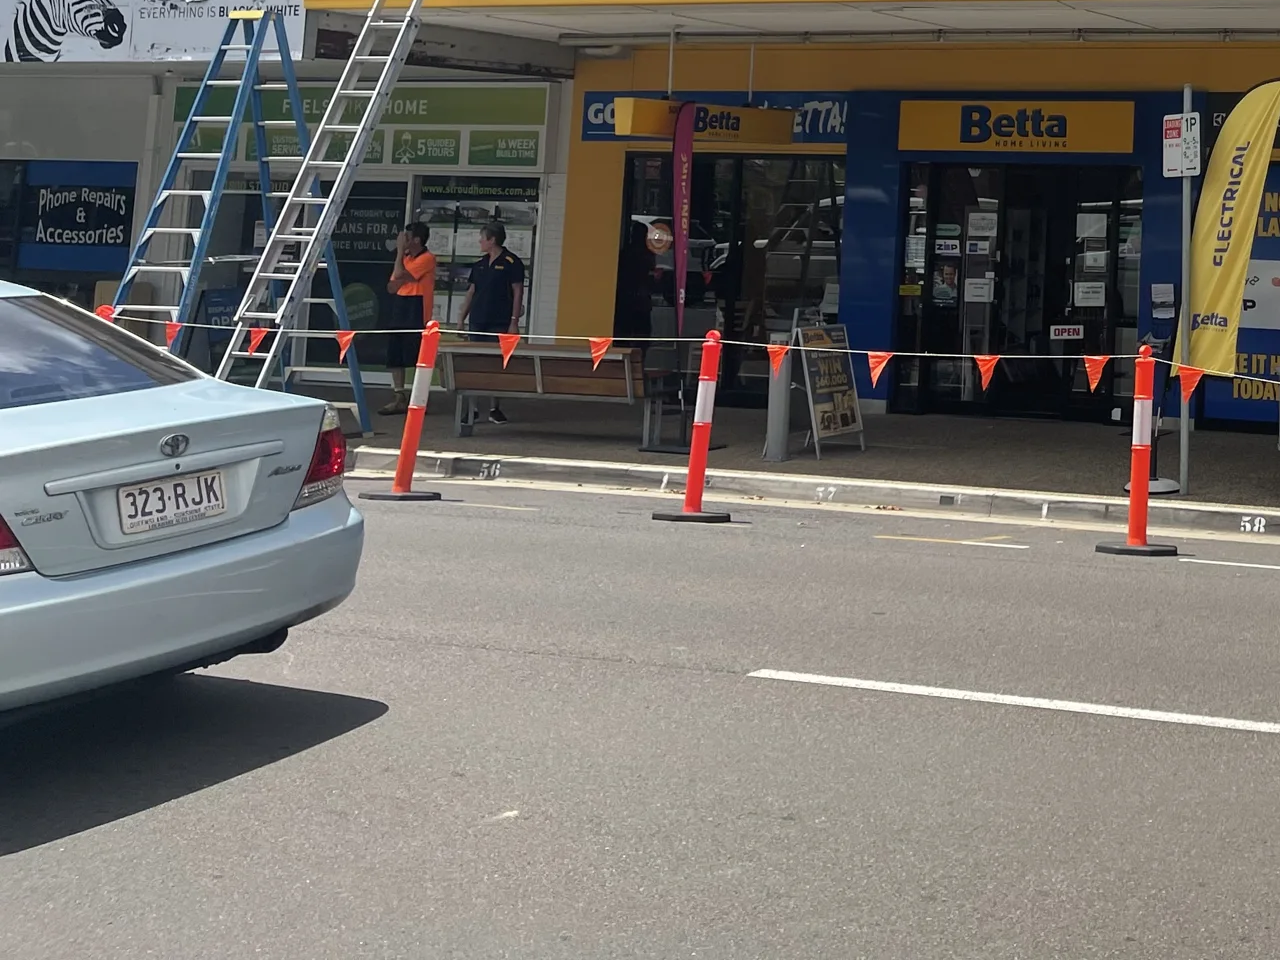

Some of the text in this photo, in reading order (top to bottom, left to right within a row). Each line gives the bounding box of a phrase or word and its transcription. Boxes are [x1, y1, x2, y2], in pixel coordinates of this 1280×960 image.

[139, 7, 204, 20] EVERYTHING
[207, 6, 216, 18] IS
[282, 99, 330, 115] FELS
[386, 100, 428, 116] HOME
[694, 106, 740, 132] Betta
[793, 101, 848, 135] ETTA!
[960, 105, 1068, 144] Betta
[1185, 117, 1197, 132] 1P
[1166, 129, 1180, 138] ZONE
[271, 143, 301, 155] SERVIC
[417, 142, 426, 157] 5
[508, 138, 536, 150] WEEK
[427, 147, 455, 157] TOURS
[518, 150, 535, 158] TIME
[38, 188, 77, 216] Phone
[81, 187, 126, 215] Repairs
[76, 207, 86, 223] &
[36, 219, 124, 244] Accessories
[333, 223, 399, 235] LANS FOR A
[1191, 313, 1228, 331] Betta
[1053, 327, 1081, 337] OPEN
[1251, 354, 1267, 375] IT
[479, 463, 501, 478] 56
[1239, 516, 1267, 534] 58
